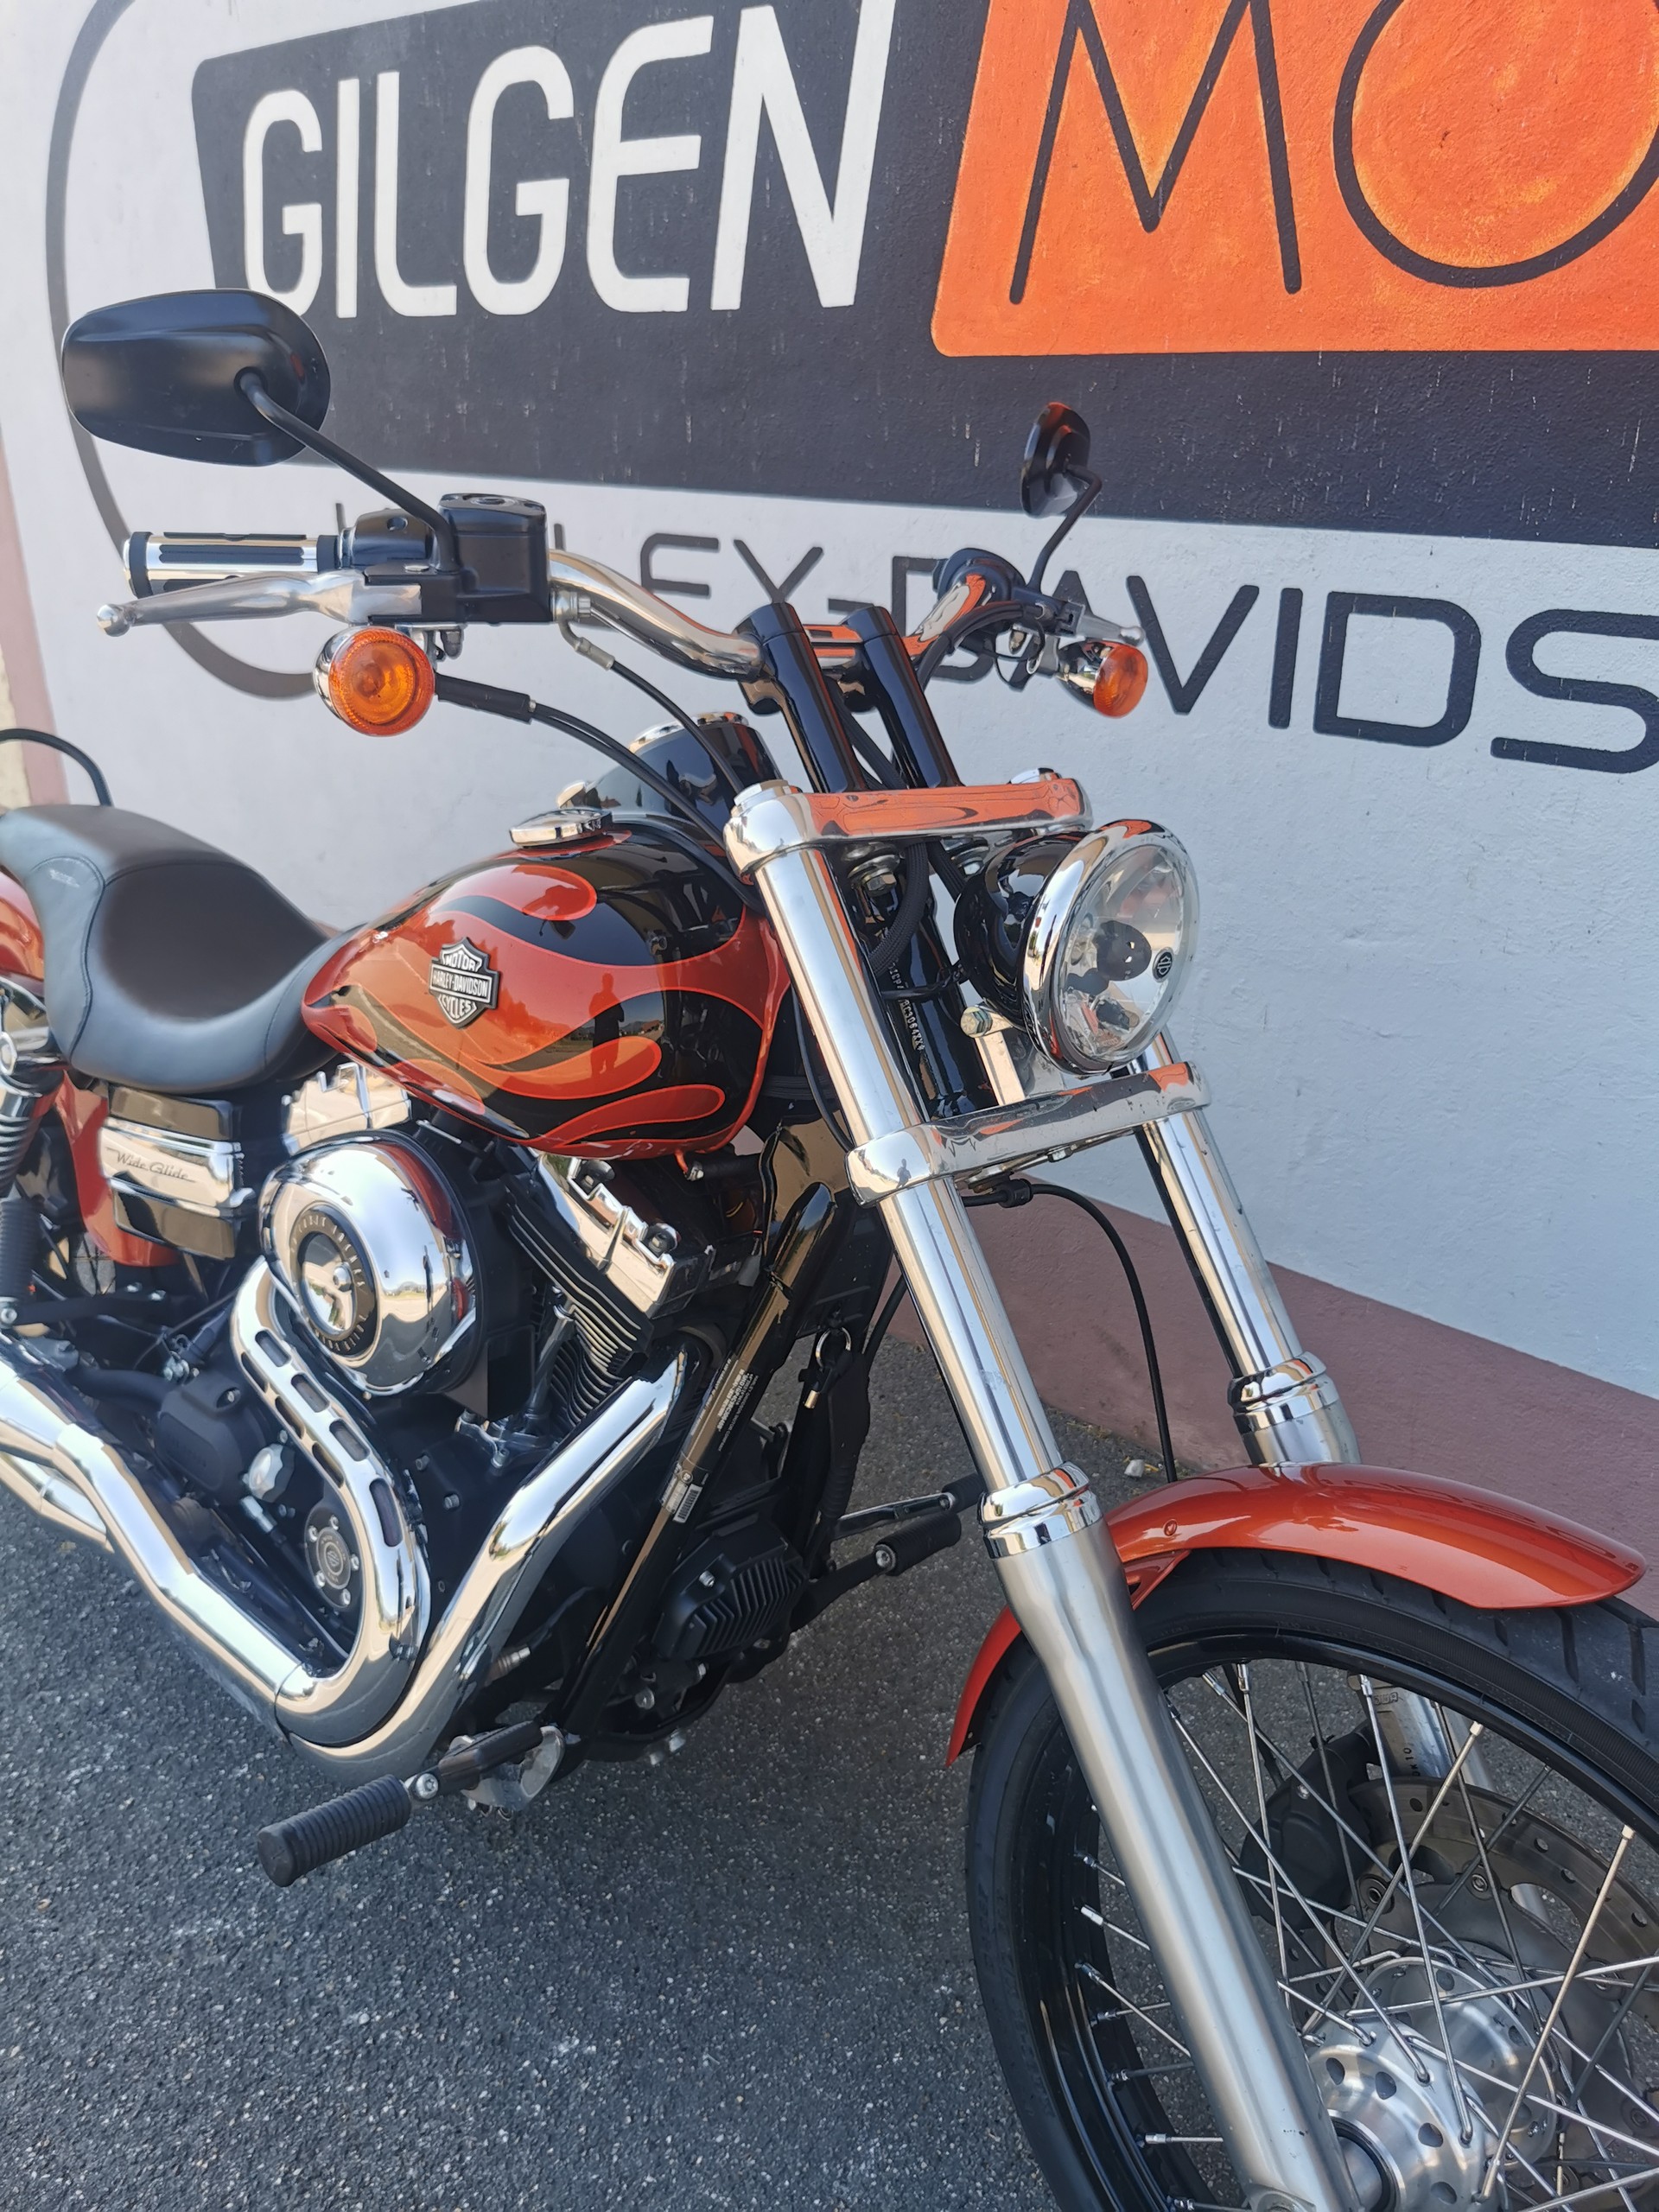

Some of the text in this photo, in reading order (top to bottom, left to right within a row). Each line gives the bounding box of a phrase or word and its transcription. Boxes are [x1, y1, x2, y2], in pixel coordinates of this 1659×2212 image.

[242, 0, 1659, 318] GILGEN MO
[445, 950, 476, 972] MOTOR
[433, 969, 488, 997] HARLEY-DAVIDSON
[442, 994, 472, 1019] CYCLES
[105, 1147, 196, 1183] Wide Glide
